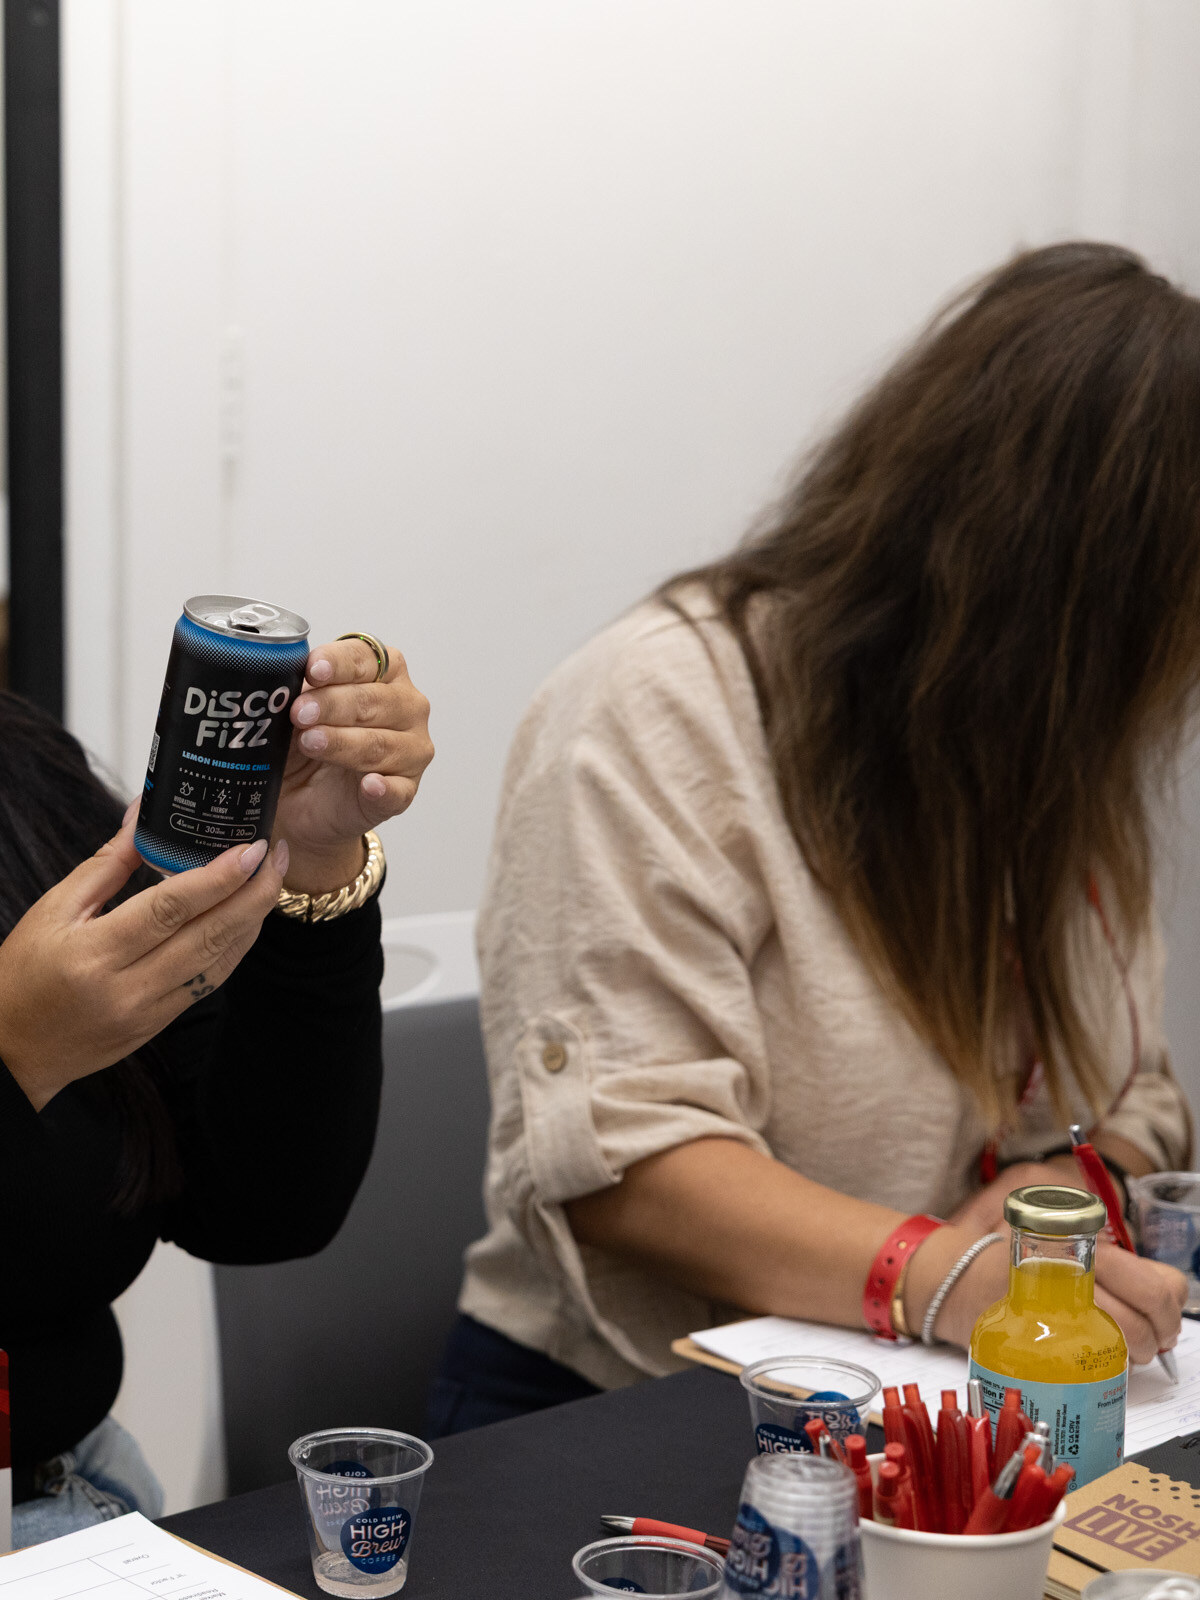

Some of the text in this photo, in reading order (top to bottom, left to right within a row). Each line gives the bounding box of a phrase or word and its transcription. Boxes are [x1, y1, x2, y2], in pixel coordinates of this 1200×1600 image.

[182, 750, 271, 771] LEMON HIBISCUS CHILL
[1069, 1434, 1074, 1443] CA
[381, 1513, 403, 1523] BREW
[350, 1519, 407, 1540] HIGH
[1075, 1511, 1177, 1557] LIVE
[351, 1535, 405, 1558] Brew
[360, 1554, 397, 1565] COFFEE
